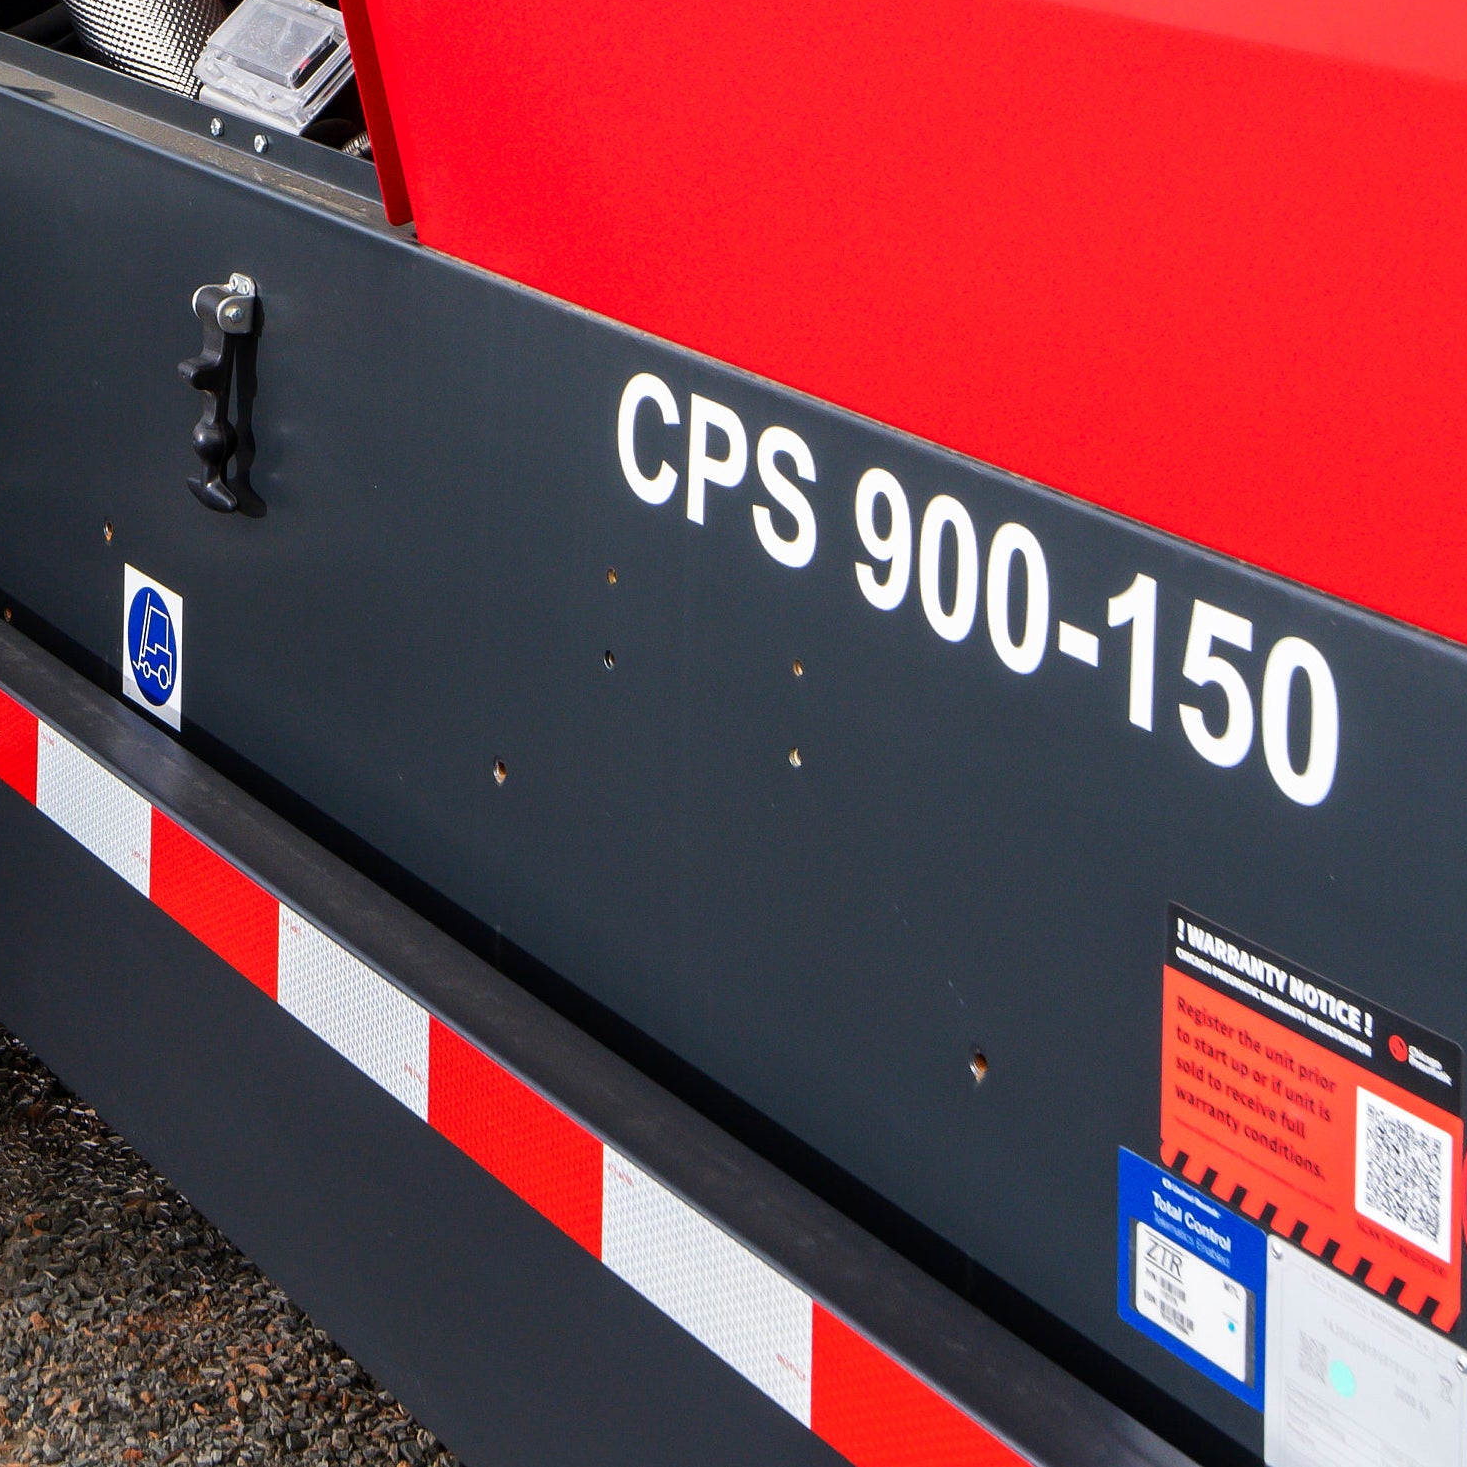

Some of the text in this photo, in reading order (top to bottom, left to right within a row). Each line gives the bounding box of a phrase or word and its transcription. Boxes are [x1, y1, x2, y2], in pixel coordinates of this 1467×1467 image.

[617, 372, 1340, 807] CPS 900-150
[1186, 923, 1288, 993] WARRANTY
[1290, 974, 1362, 1032] NOTICE
[1177, 995, 1336, 1093] Register the unit prior
[1177, 1026, 1331, 1122] to start up or if unit is
[1176, 1056, 1306, 1139] sold to receive full
[1176, 1085, 1239, 1134] warranty
[1244, 1124, 1326, 1182] conditions.
[1146, 1237, 1183, 1277] ZTR
[1152, 1190, 1232, 1253] Total Control
